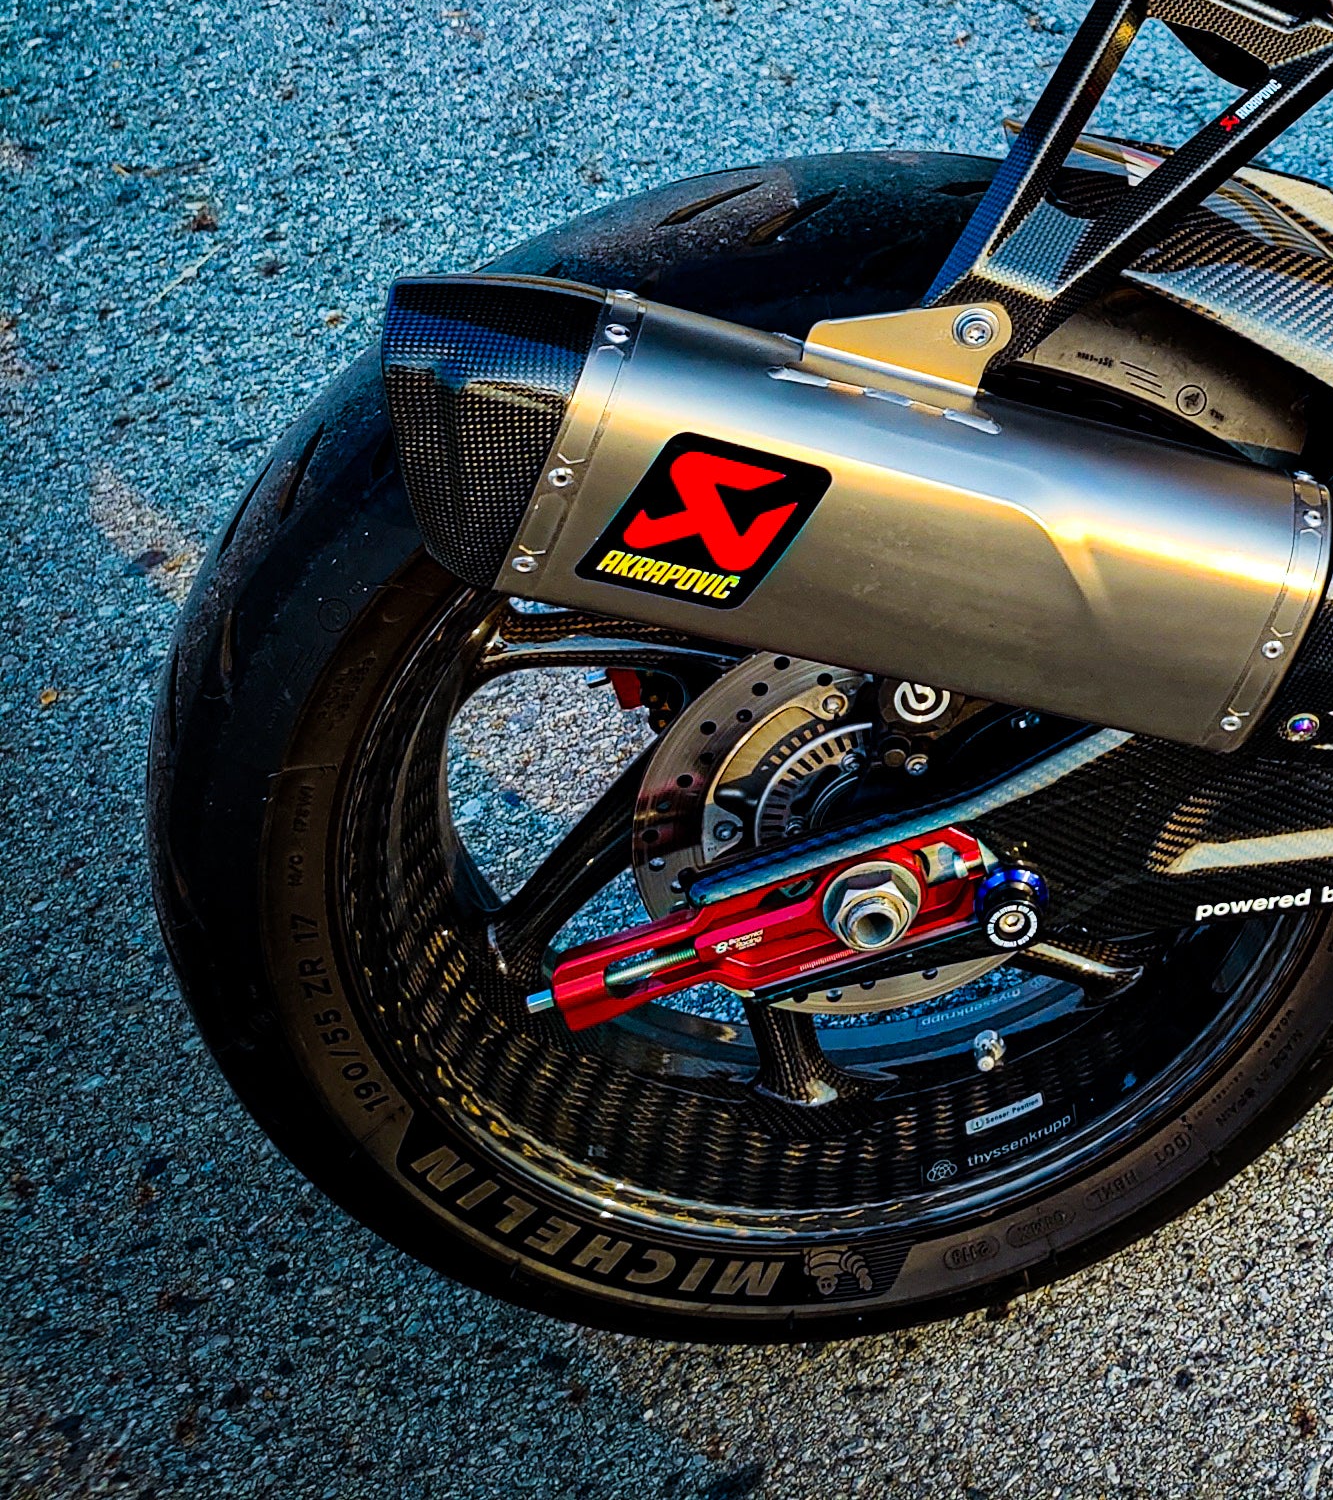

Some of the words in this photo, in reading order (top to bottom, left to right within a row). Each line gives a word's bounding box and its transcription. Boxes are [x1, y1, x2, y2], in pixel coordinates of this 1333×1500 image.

[1195, 886, 1312, 921] powered
[290, 913, 320, 944] 17
[299, 956, 334, 1000] ZR
[313, 1008, 391, 1113] 190/55
[985, 1110, 1010, 1125] Sensor
[1011, 1098, 1039, 1114] Position
[966, 1114, 1072, 1168] thyssenkrupp
[409, 1144, 786, 1298] MICHELIN
